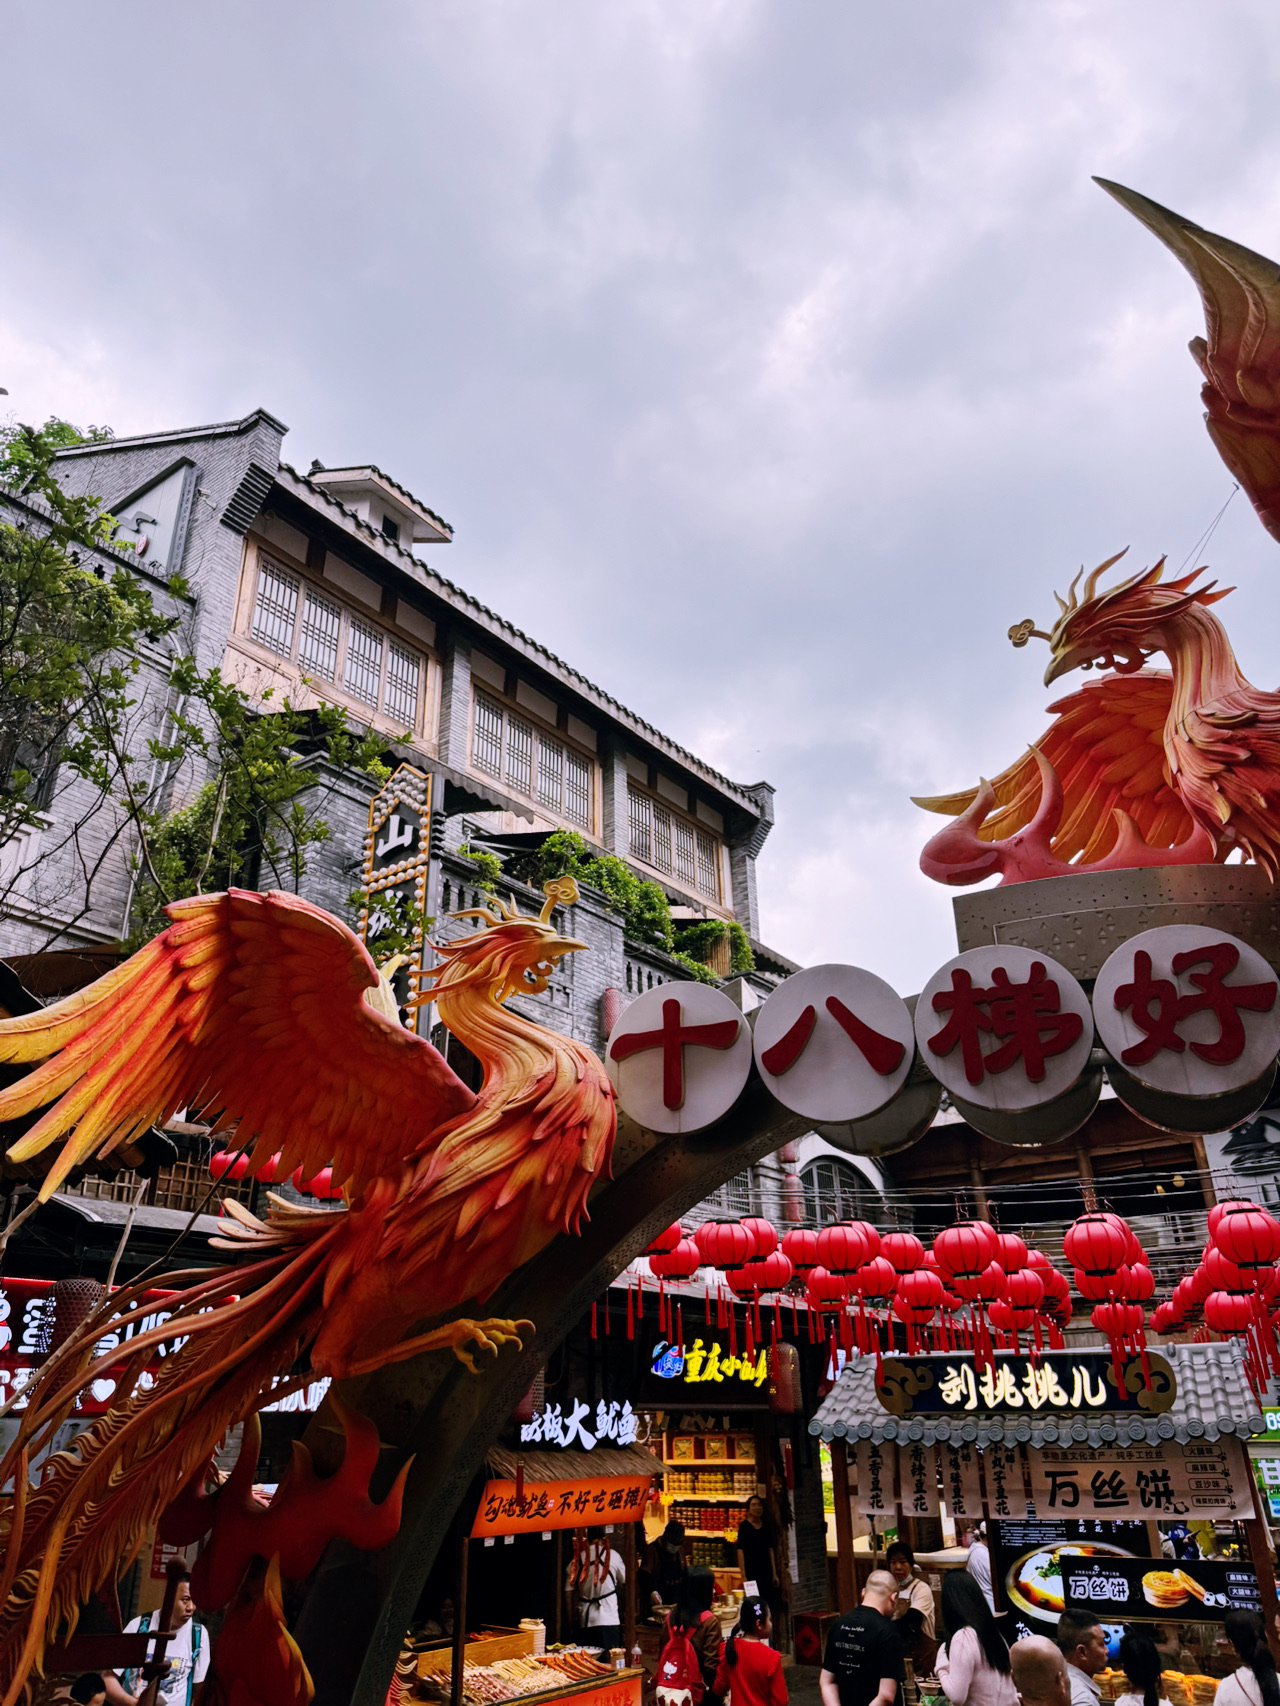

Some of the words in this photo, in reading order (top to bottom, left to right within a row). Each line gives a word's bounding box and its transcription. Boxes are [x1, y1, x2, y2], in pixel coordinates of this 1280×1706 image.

[938, 1361, 1108, 1411] 刘挑挑儿
[868, 1445, 885, 1510] 五香豆花
[910, 1445, 929, 1512] 香辣豆花
[1044, 1469, 1174, 1509] 万丝饼
[1194, 1480, 1221, 1488] 豆沙味
[1069, 1576, 1129, 1602] 万丝饼
